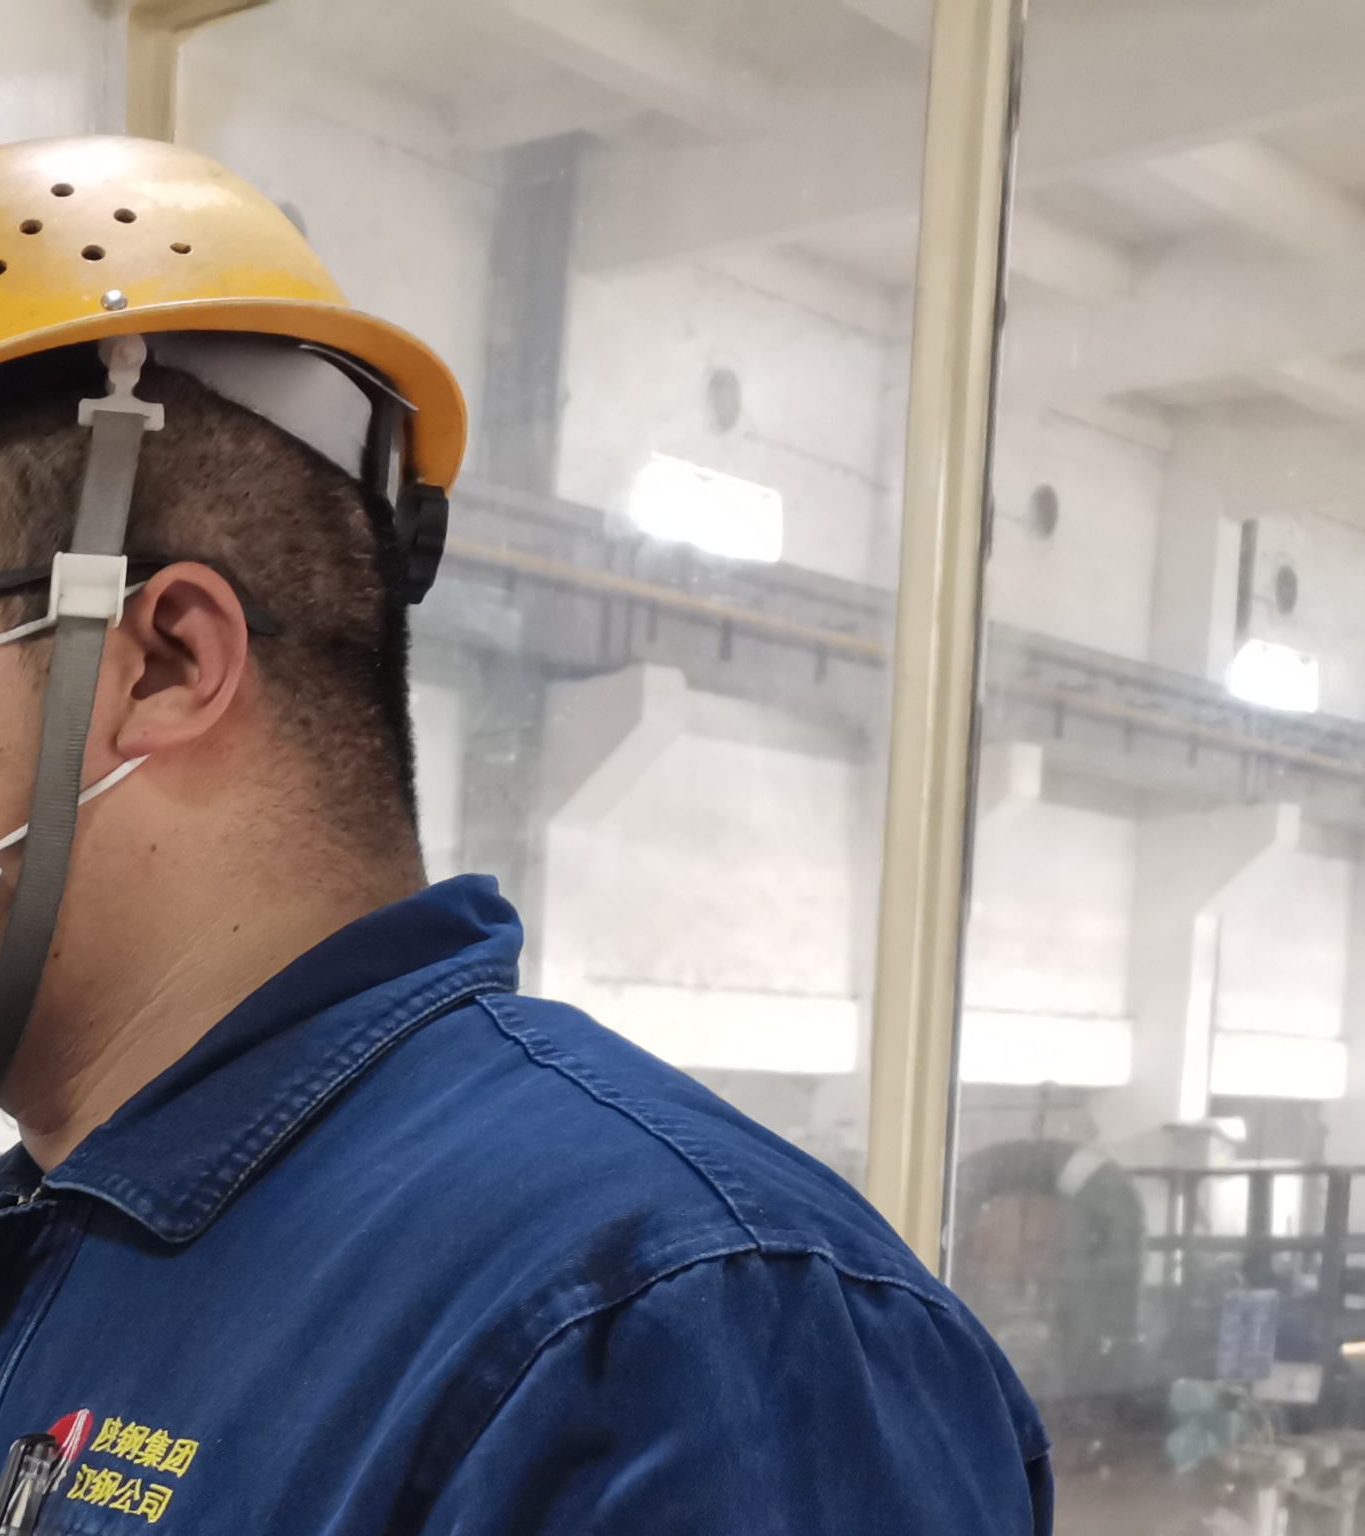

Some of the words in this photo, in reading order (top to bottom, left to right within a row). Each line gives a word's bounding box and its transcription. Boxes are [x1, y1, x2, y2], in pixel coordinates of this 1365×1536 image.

[89, 1415, 201, 1479] 陕钢集团
[66, 1462, 174, 1525] 汉钢公司
